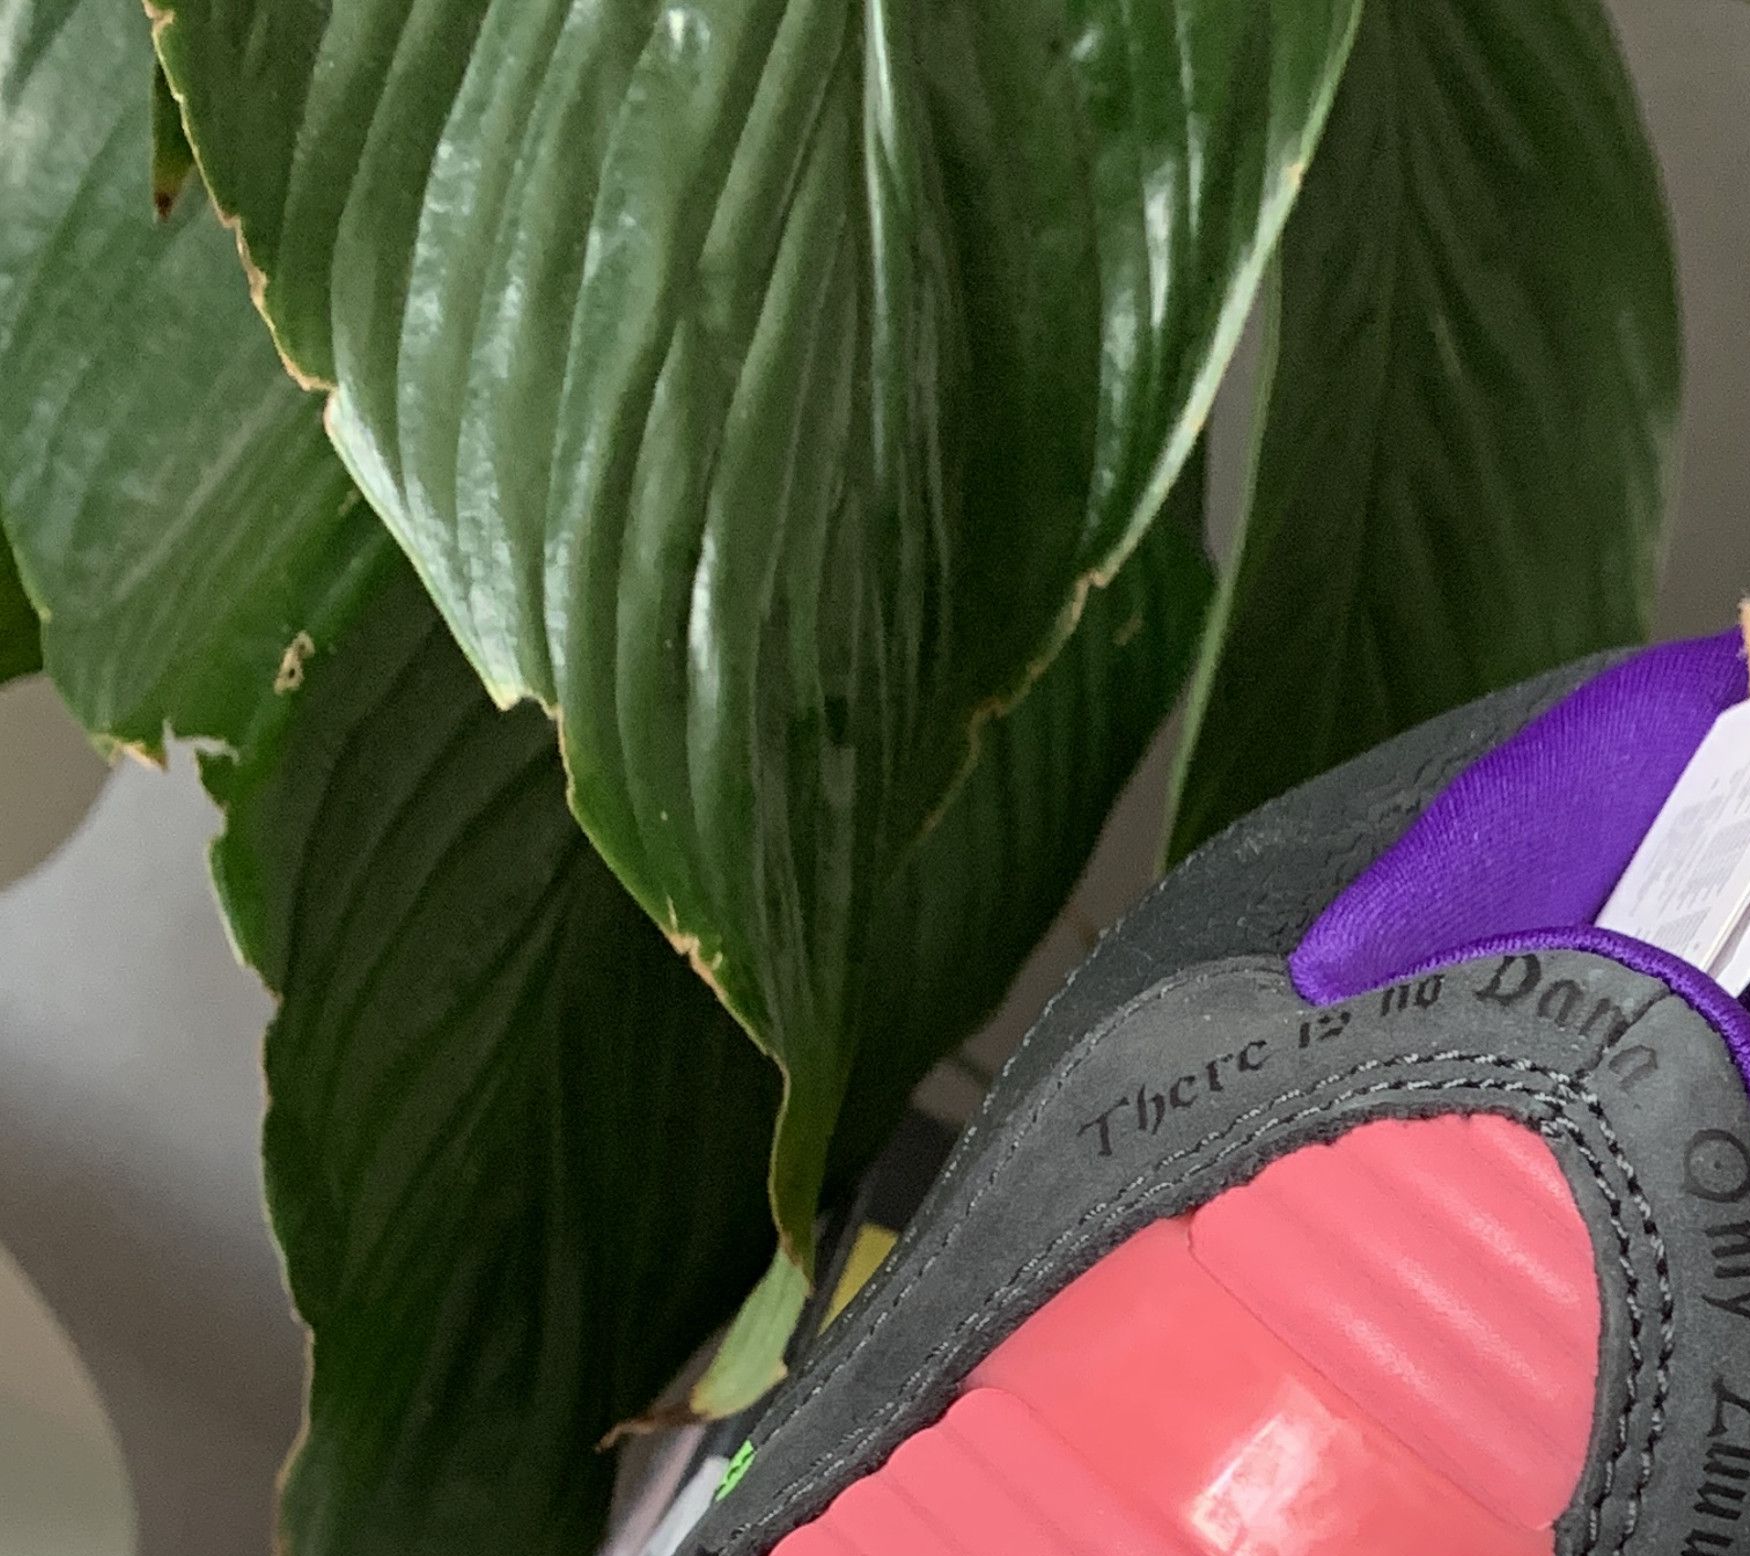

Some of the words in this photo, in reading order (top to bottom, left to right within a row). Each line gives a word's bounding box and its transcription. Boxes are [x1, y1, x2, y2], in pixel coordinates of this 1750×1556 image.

[1075, 1040, 1272, 1157] There
[1298, 1010, 1352, 1050] is
[1380, 974, 1446, 1017] no
[1473, 952, 1659, 1093] Dana
